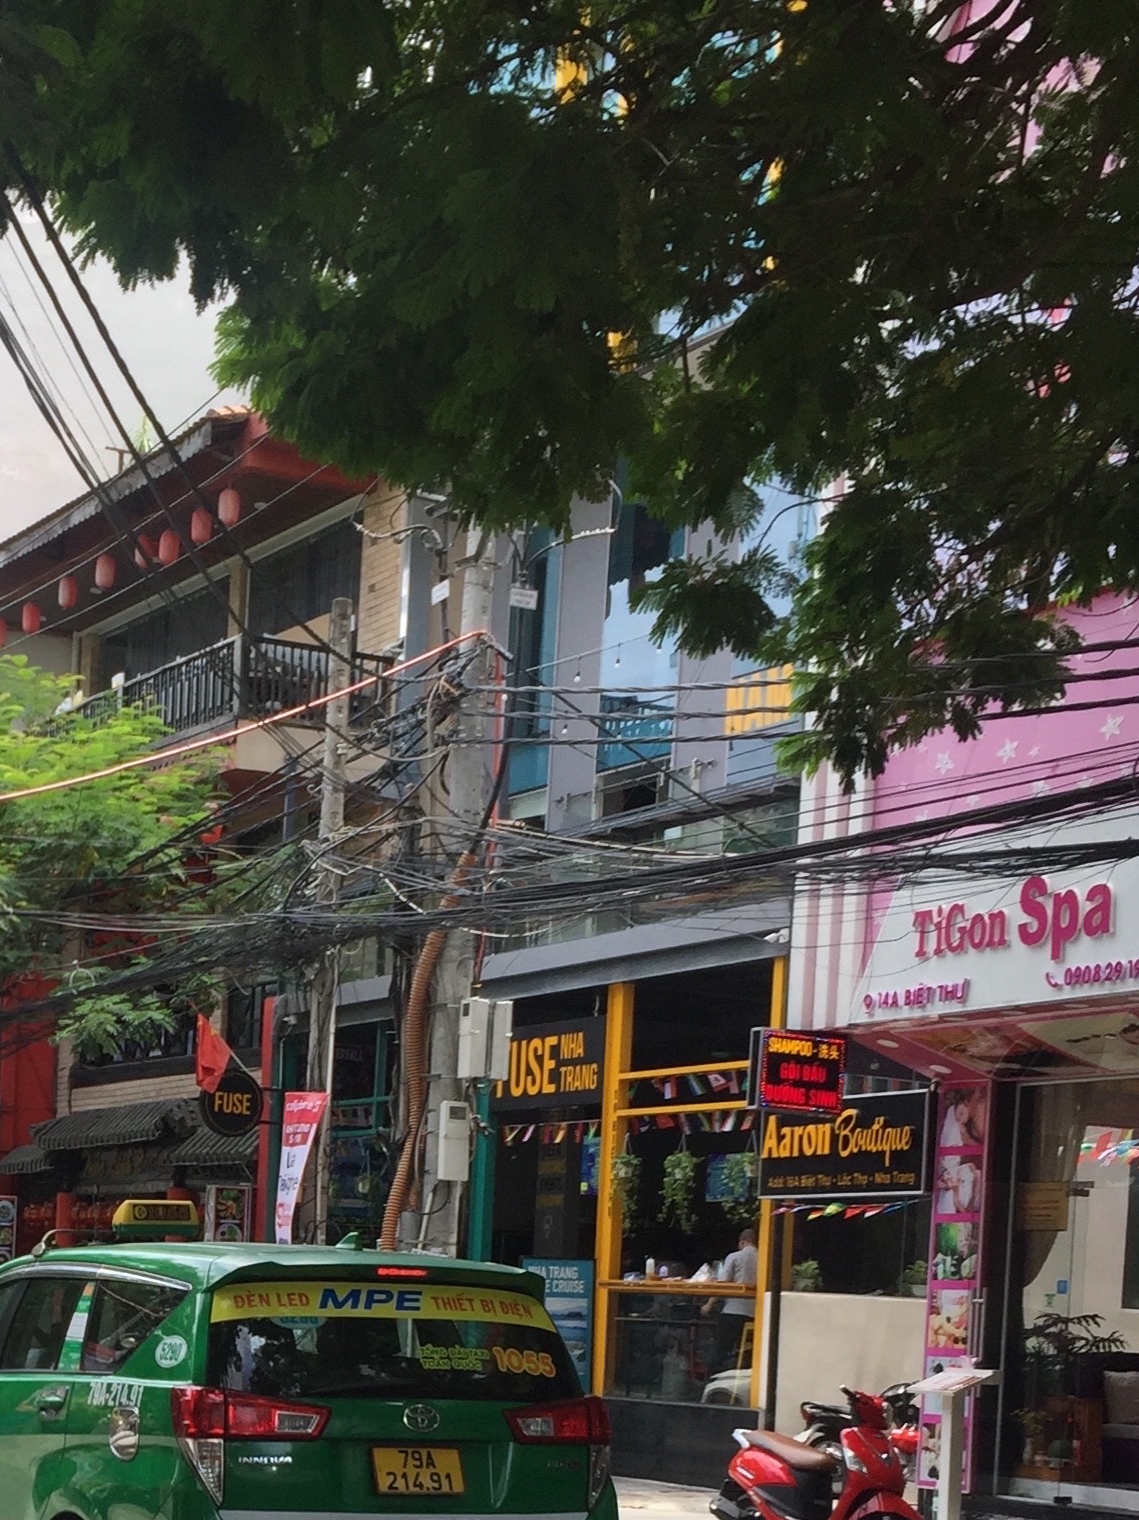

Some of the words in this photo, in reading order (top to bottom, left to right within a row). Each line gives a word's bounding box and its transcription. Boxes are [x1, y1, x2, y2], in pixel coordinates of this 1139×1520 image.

[913, 902, 1008, 958] TiGon
[1018, 875, 1112, 961] Spa
[877, 991, 900, 1009] 14A
[904, 982, 932, 1010] BIỆT
[560, 1031, 584, 1059] NHA
[768, 1036, 813, 1057] SHAMPOO
[560, 1062, 598, 1093] TRANG
[213, 1091, 253, 1116] FUSE
[761, 1115, 831, 1159] Aaron
[834, 1108, 915, 1167] Boutique
[548, 1266, 579, 1280] TRANG
[552, 1280, 585, 1294] CRUISE
[233, 1290, 272, 1309] ĐÈN
[276, 1292, 310, 1308] LED
[319, 1288, 422, 1312] MPE
[430, 1290, 476, 1312] THIẾT
[481, 1298, 496, 1317] BỊ
[499, 1298, 533, 1319] ĐIỆN
[492, 1346, 556, 1378] 1055
[87, 1381, 144, 1408] 79A-214.91
[397, 1449, 437, 1470] 79A
[386, 1471, 454, 1491] 214.91
